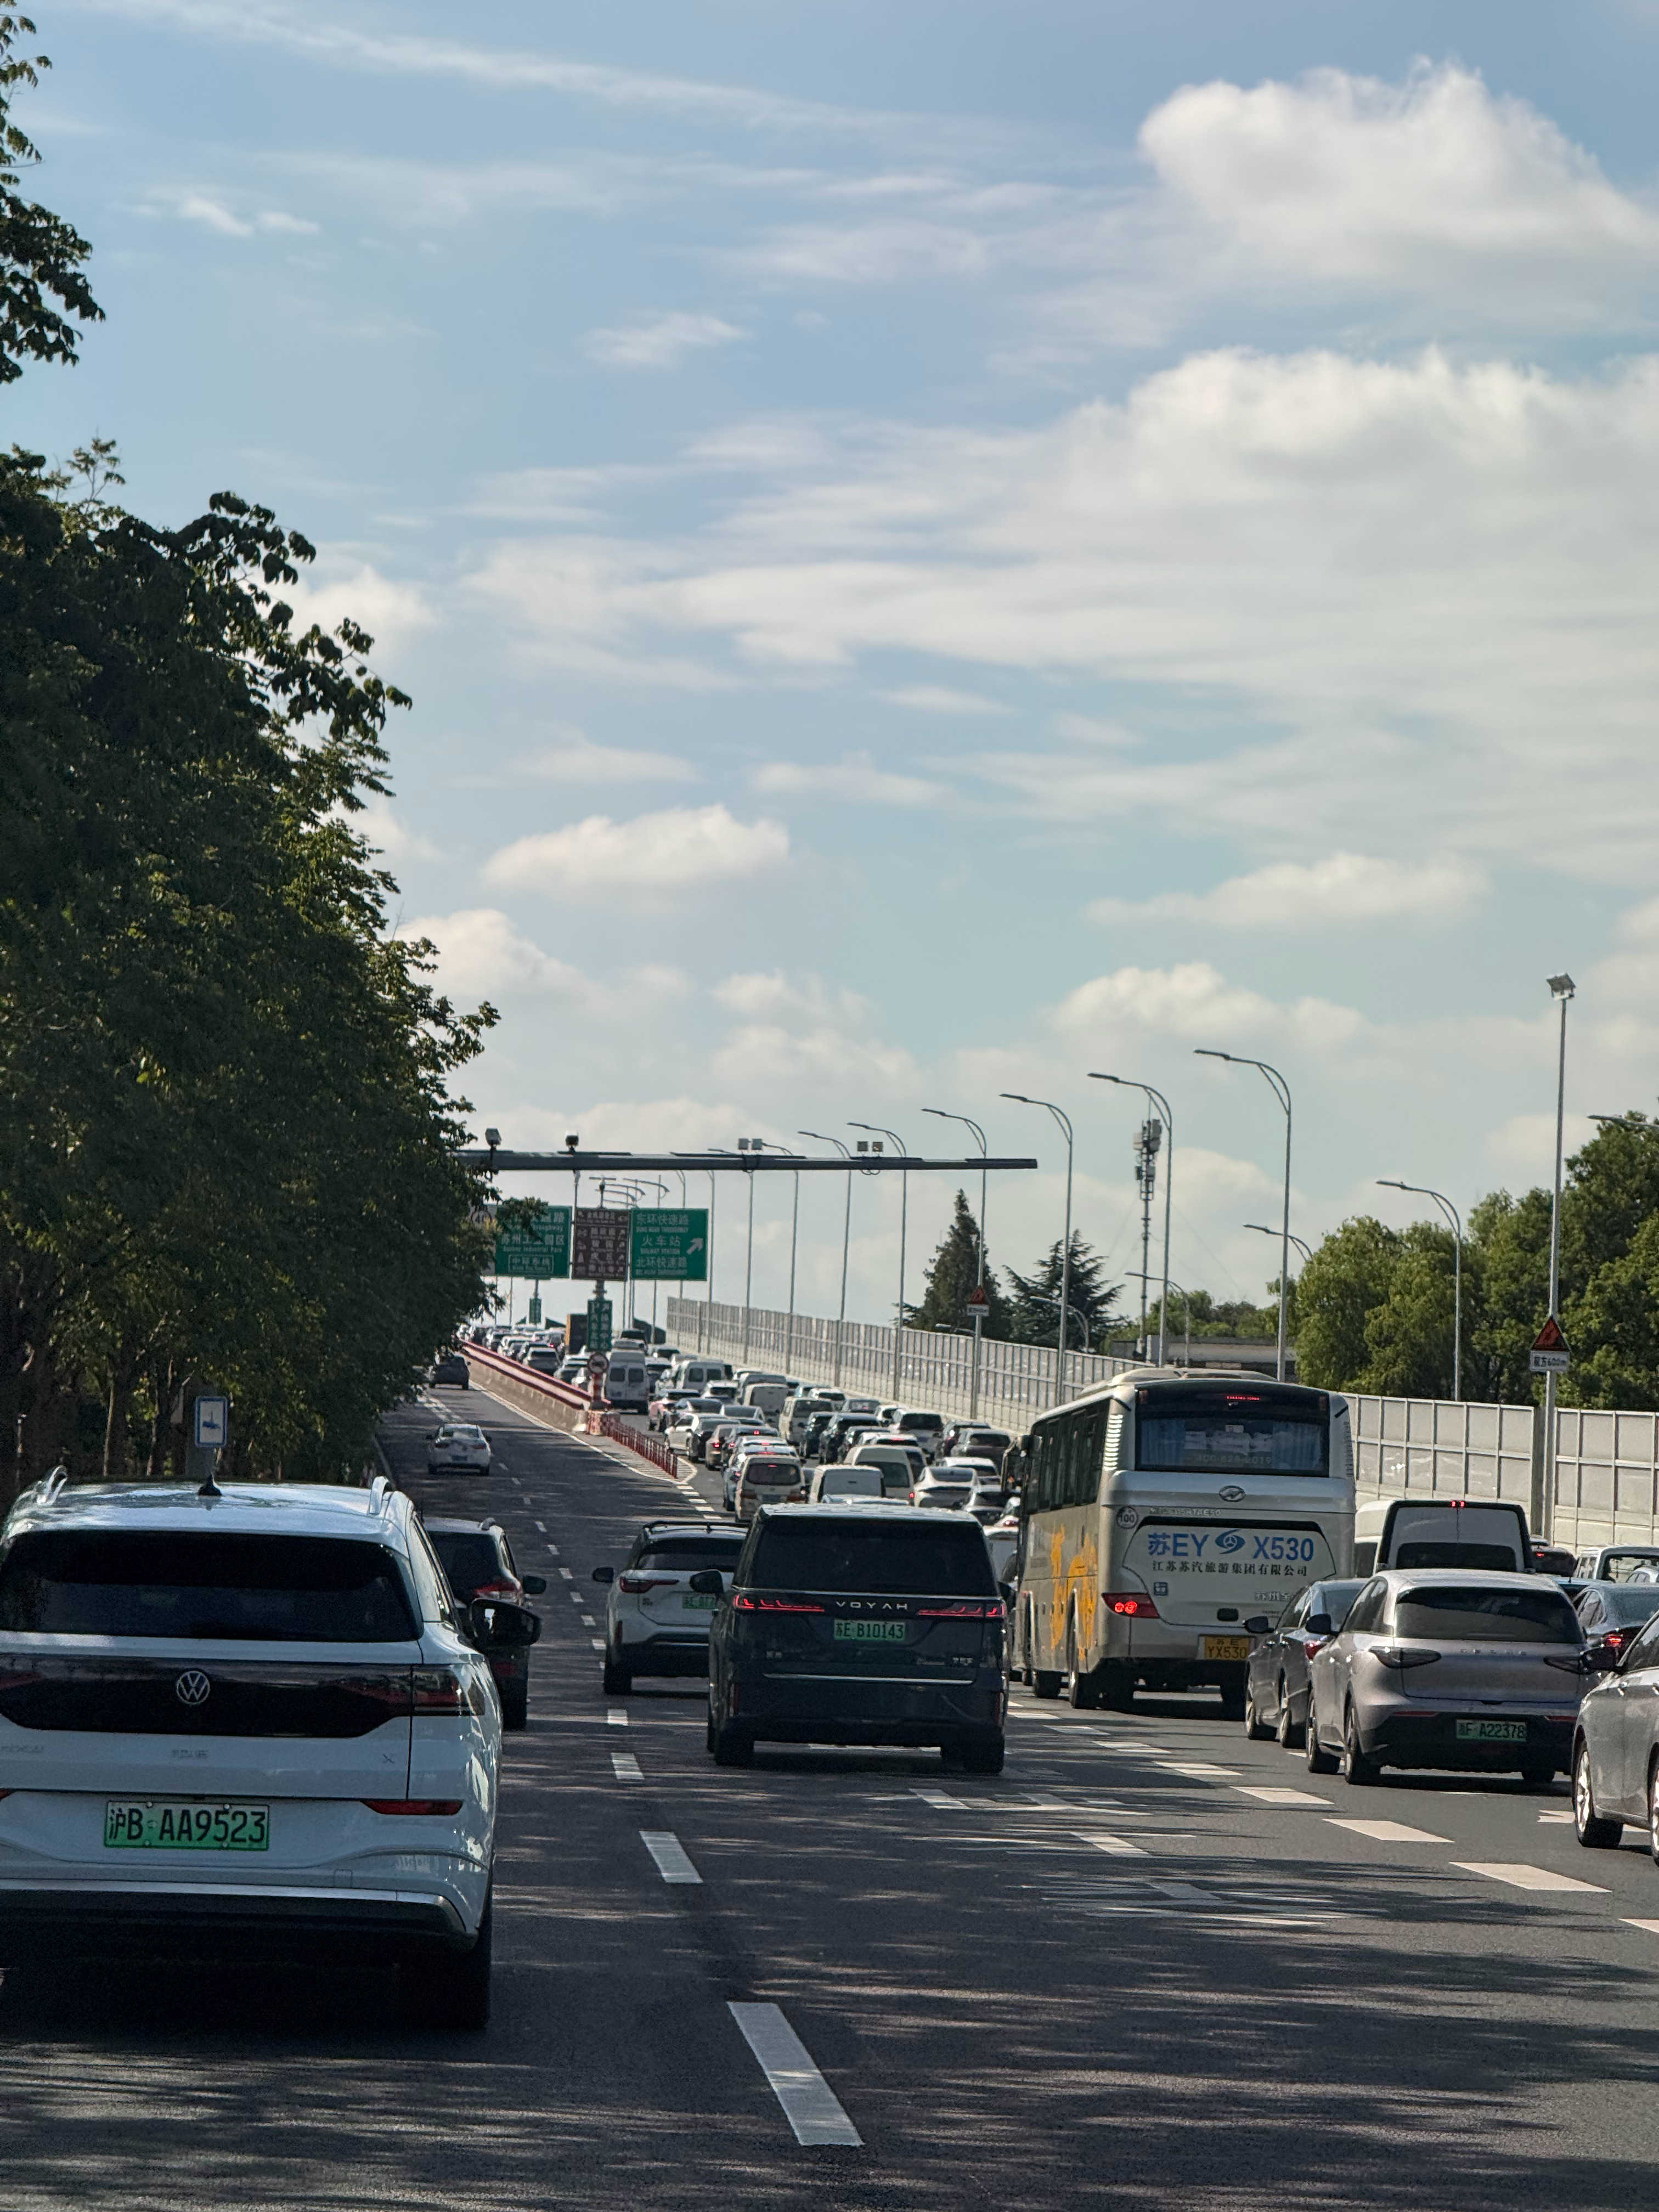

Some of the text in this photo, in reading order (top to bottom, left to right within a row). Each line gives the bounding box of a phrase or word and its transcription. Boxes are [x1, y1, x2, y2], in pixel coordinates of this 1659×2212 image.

[636, 1212, 689, 1225] 东环快速路
[641, 1234, 681, 1247] 火车站
[636, 1256, 687, 1268] 北环快速路
[1119, 1514, 1135, 1522] 100
[1148, 1532, 1314, 1561] 苏EY X530
[1153, 1560, 1307, 1576] 江苏苏汽旅游集团有限公司
[1255, 1592, 1295, 1601] 苏州金
[836, 1601, 907, 1610] VOYAH
[1208, 1646, 1248, 1659] YX530
